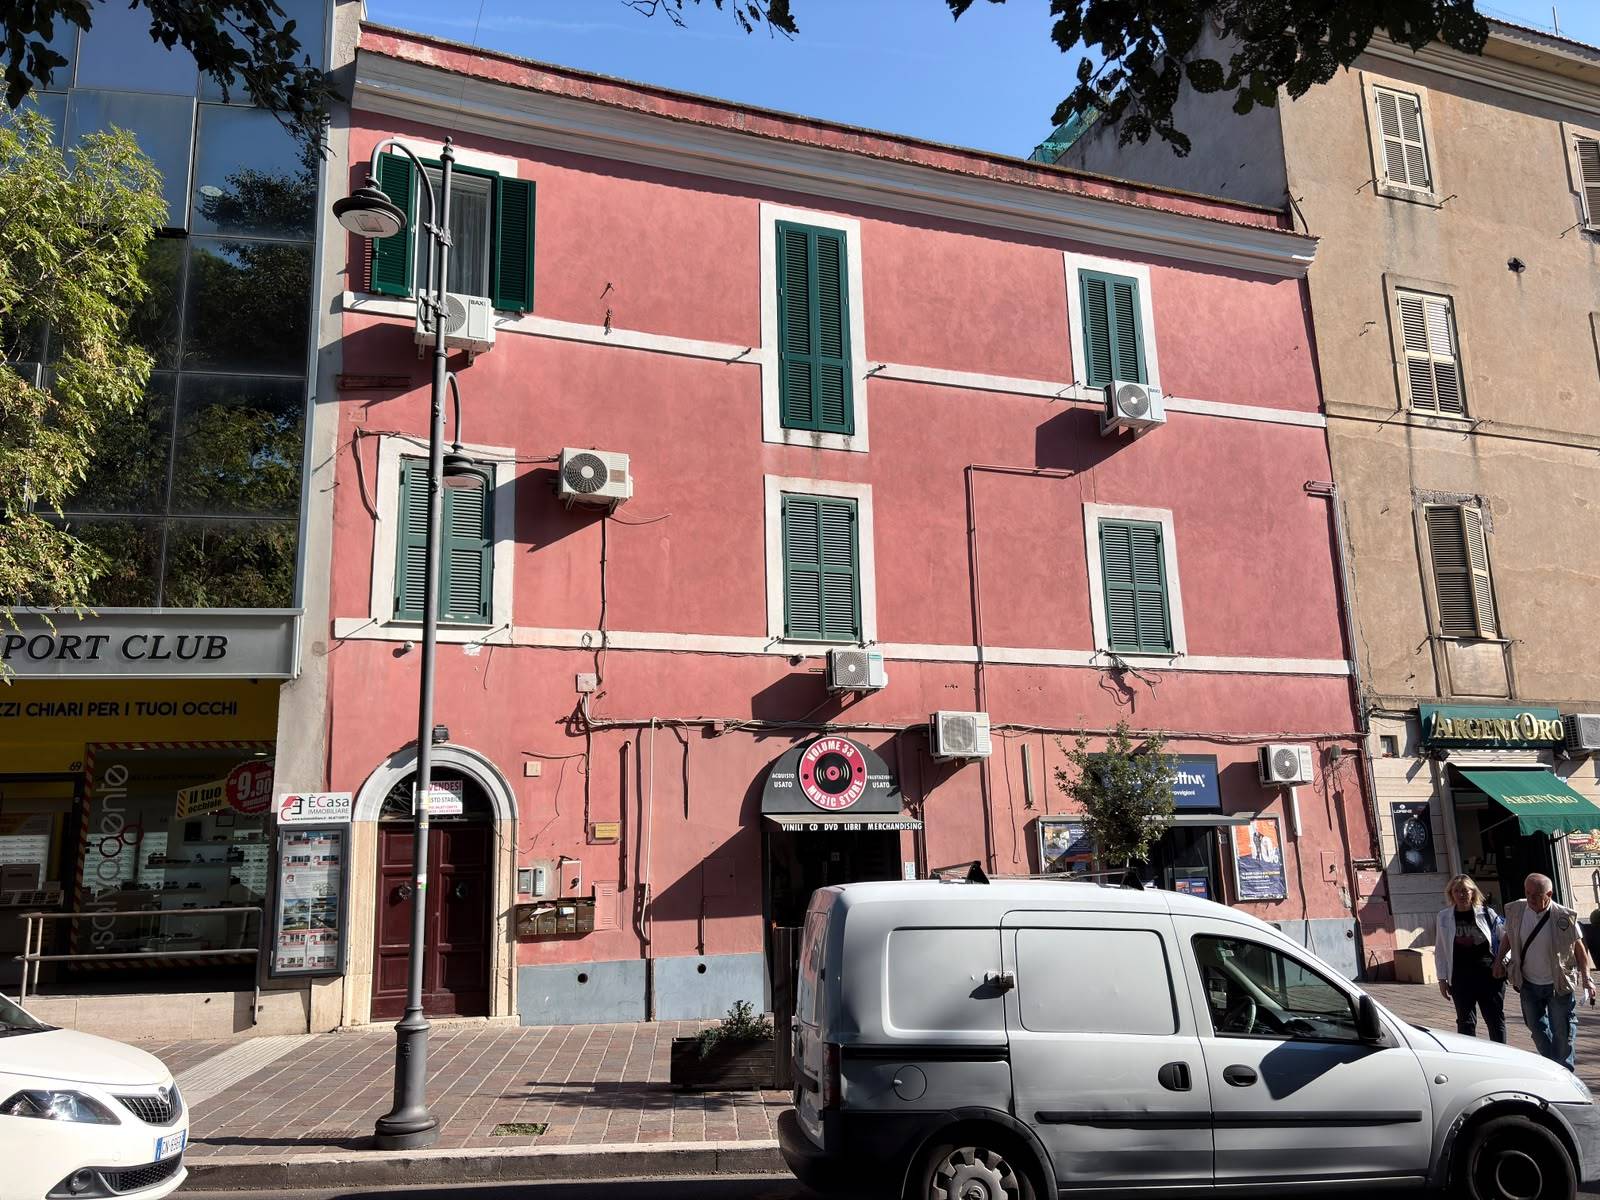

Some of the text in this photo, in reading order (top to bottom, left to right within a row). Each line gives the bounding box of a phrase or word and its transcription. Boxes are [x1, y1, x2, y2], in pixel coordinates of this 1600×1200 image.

[3, 634, 229, 660] PORT CLUB
[26, 702, 83, 717] CHIARI
[88, 702, 120, 716] PER
[124, 702, 130, 716] I
[135, 701, 178, 716] TUOI
[182, 700, 238, 716] OCCHI
[806, 739, 855, 762] VOLUME 33
[70, 761, 82, 772] 69
[428, 781, 462, 791] VENDESI
[872, 781, 891, 789] USATO
[200, 786, 222, 801] tuo
[806, 778, 864, 807] MUSIC STORE
[307, 807, 350, 815] IMMOBILIARE
[781, 822, 923, 831] VINILI CD DVD LIBRI MERCHANDISING
